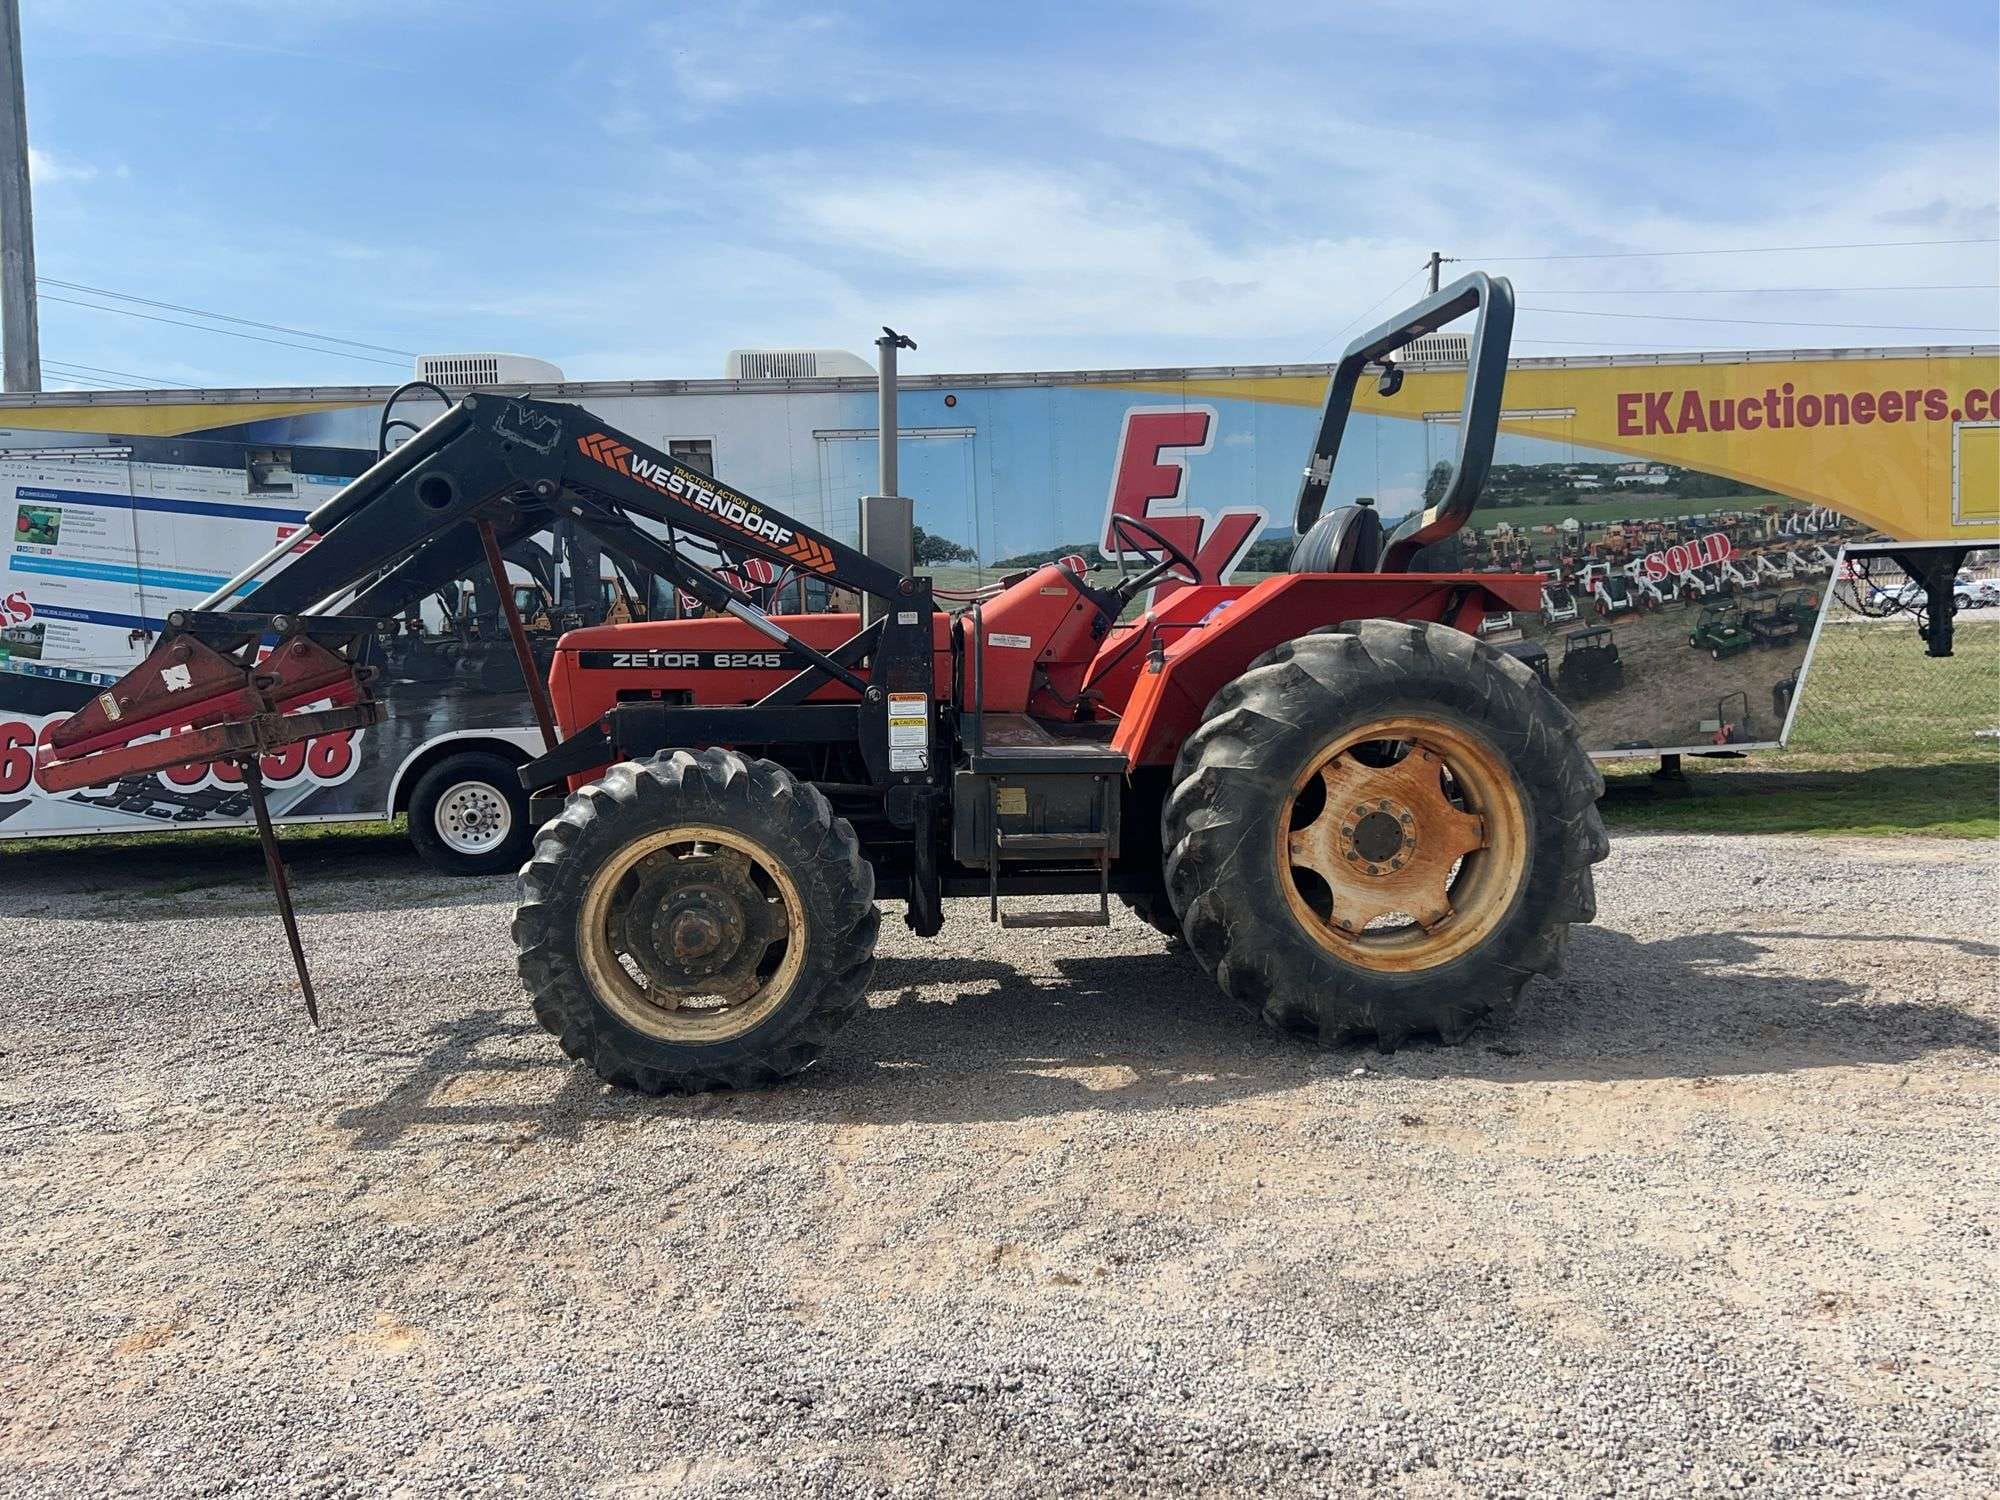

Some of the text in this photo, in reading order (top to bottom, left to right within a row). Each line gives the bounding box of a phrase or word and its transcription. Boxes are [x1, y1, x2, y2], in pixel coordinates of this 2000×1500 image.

[631, 453, 793, 545] WESTENDORF
[673, 465, 763, 515] TRACTION ACTION BY
[1644, 533, 1731, 584] SOLD
[613, 653, 781, 668] ZETOR 6245
